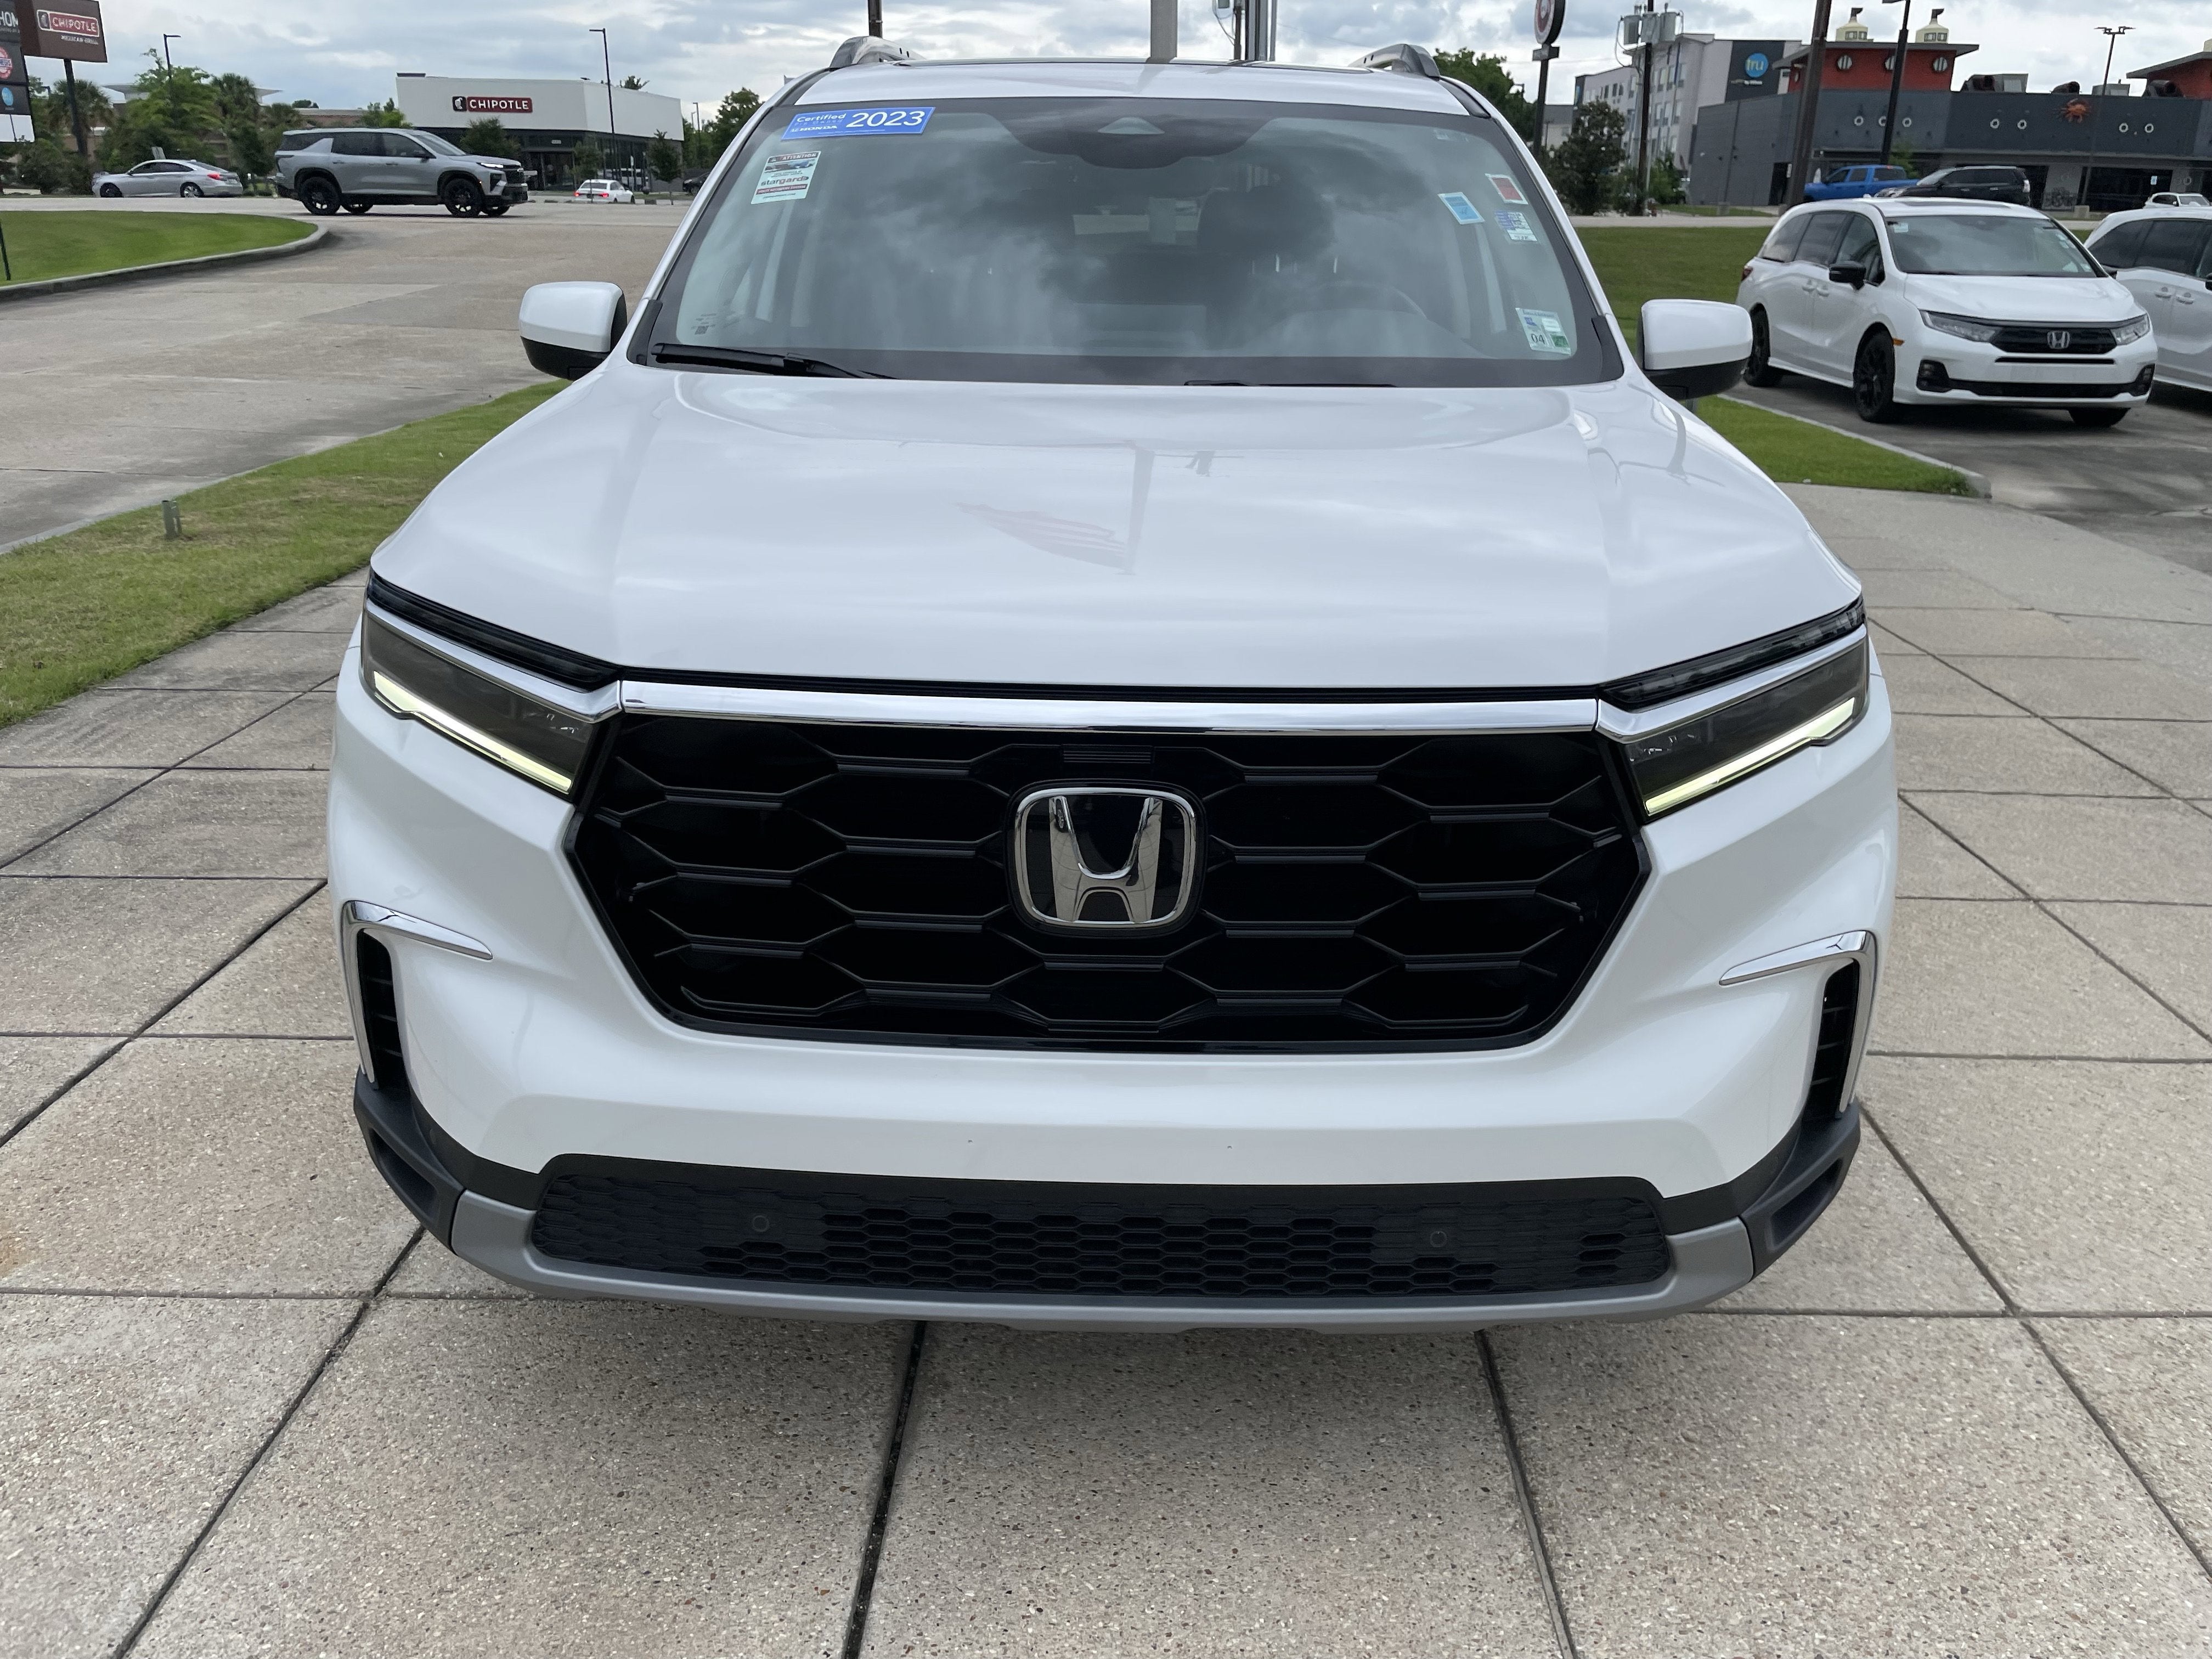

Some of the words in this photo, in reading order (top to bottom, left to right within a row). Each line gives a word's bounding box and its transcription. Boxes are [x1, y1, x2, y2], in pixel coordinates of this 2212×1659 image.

[52, 17, 97, 32] CHIPOTLE
[469, 99, 529, 110] CHIPOTLE
[797, 112, 847, 122] Certified
[845, 111, 926, 128] 2023
[782, 153, 817, 161] ATTENTION
[1531, 333, 1546, 345] 04
